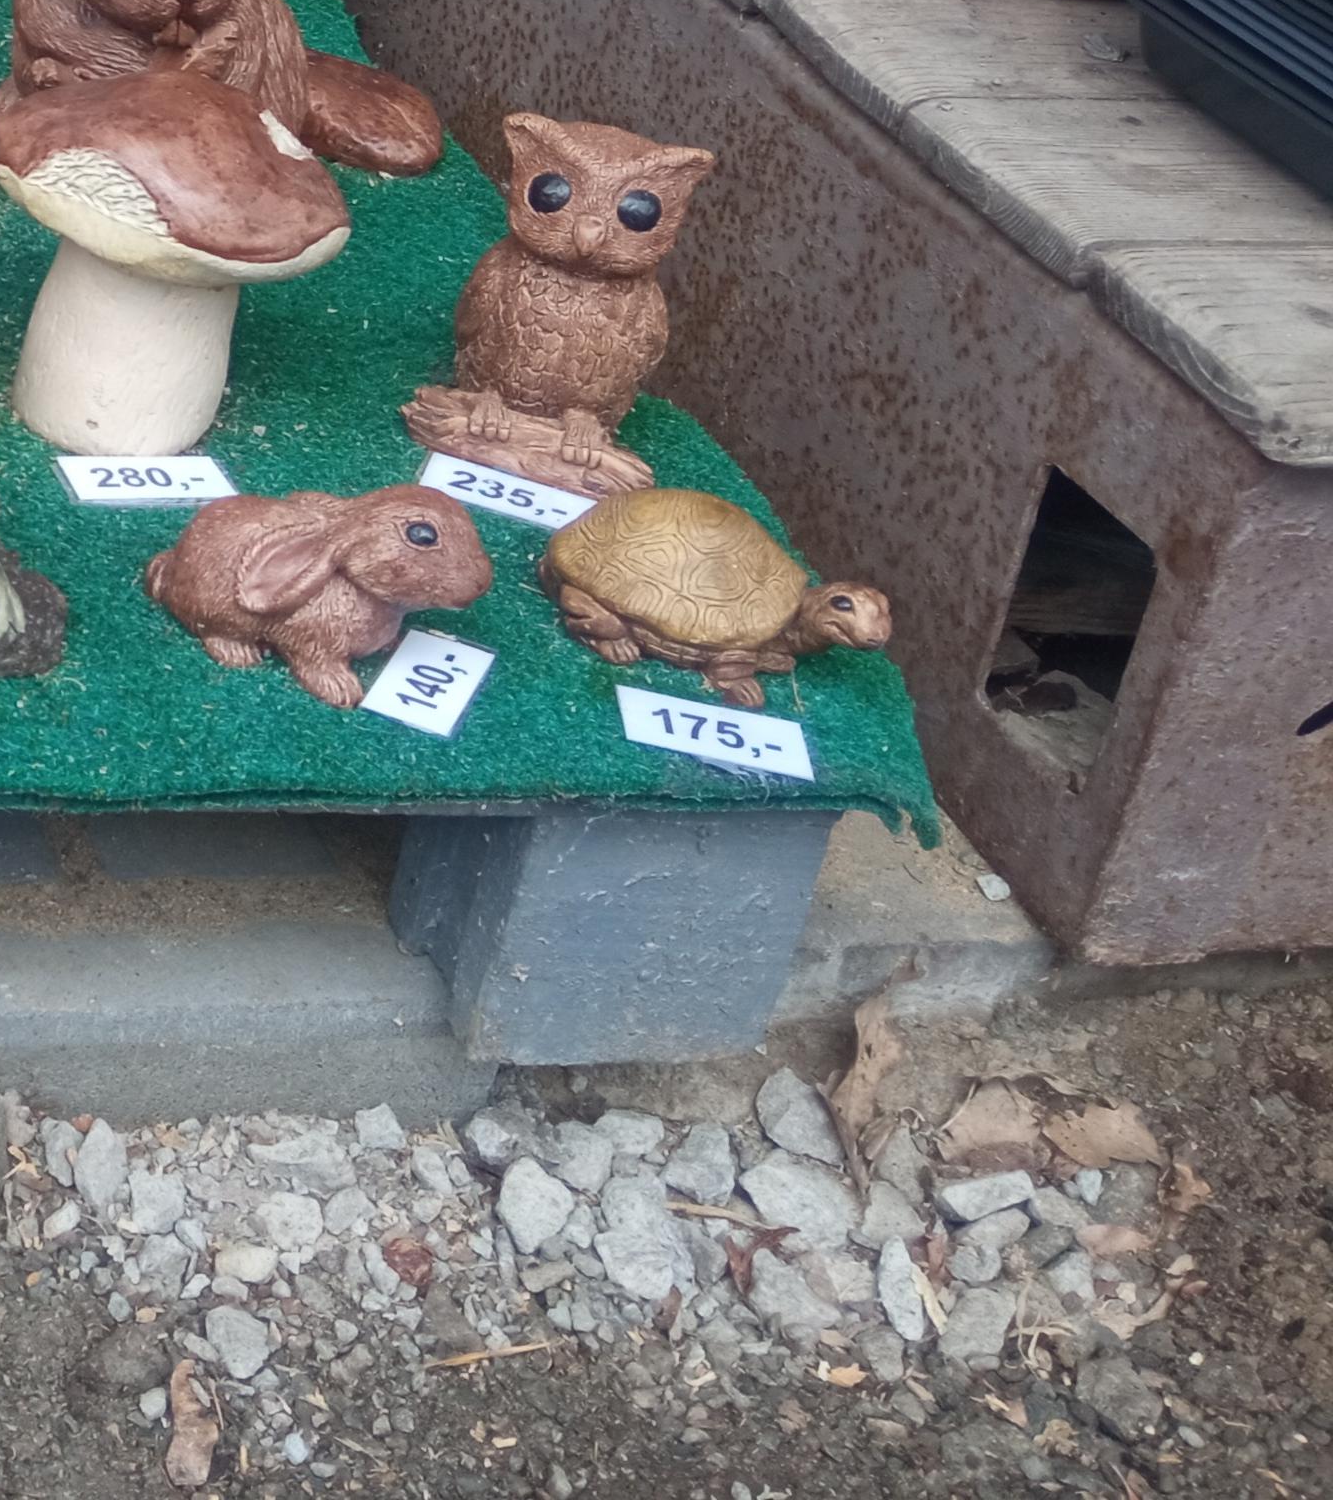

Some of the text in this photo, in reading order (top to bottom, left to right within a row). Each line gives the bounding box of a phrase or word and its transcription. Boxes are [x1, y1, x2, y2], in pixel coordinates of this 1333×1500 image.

[90, 467, 205, 491] 280,-
[447, 470, 568, 516] 235,-
[396, 654, 468, 710] 140,-
[652, 708, 783, 758] 175,-
